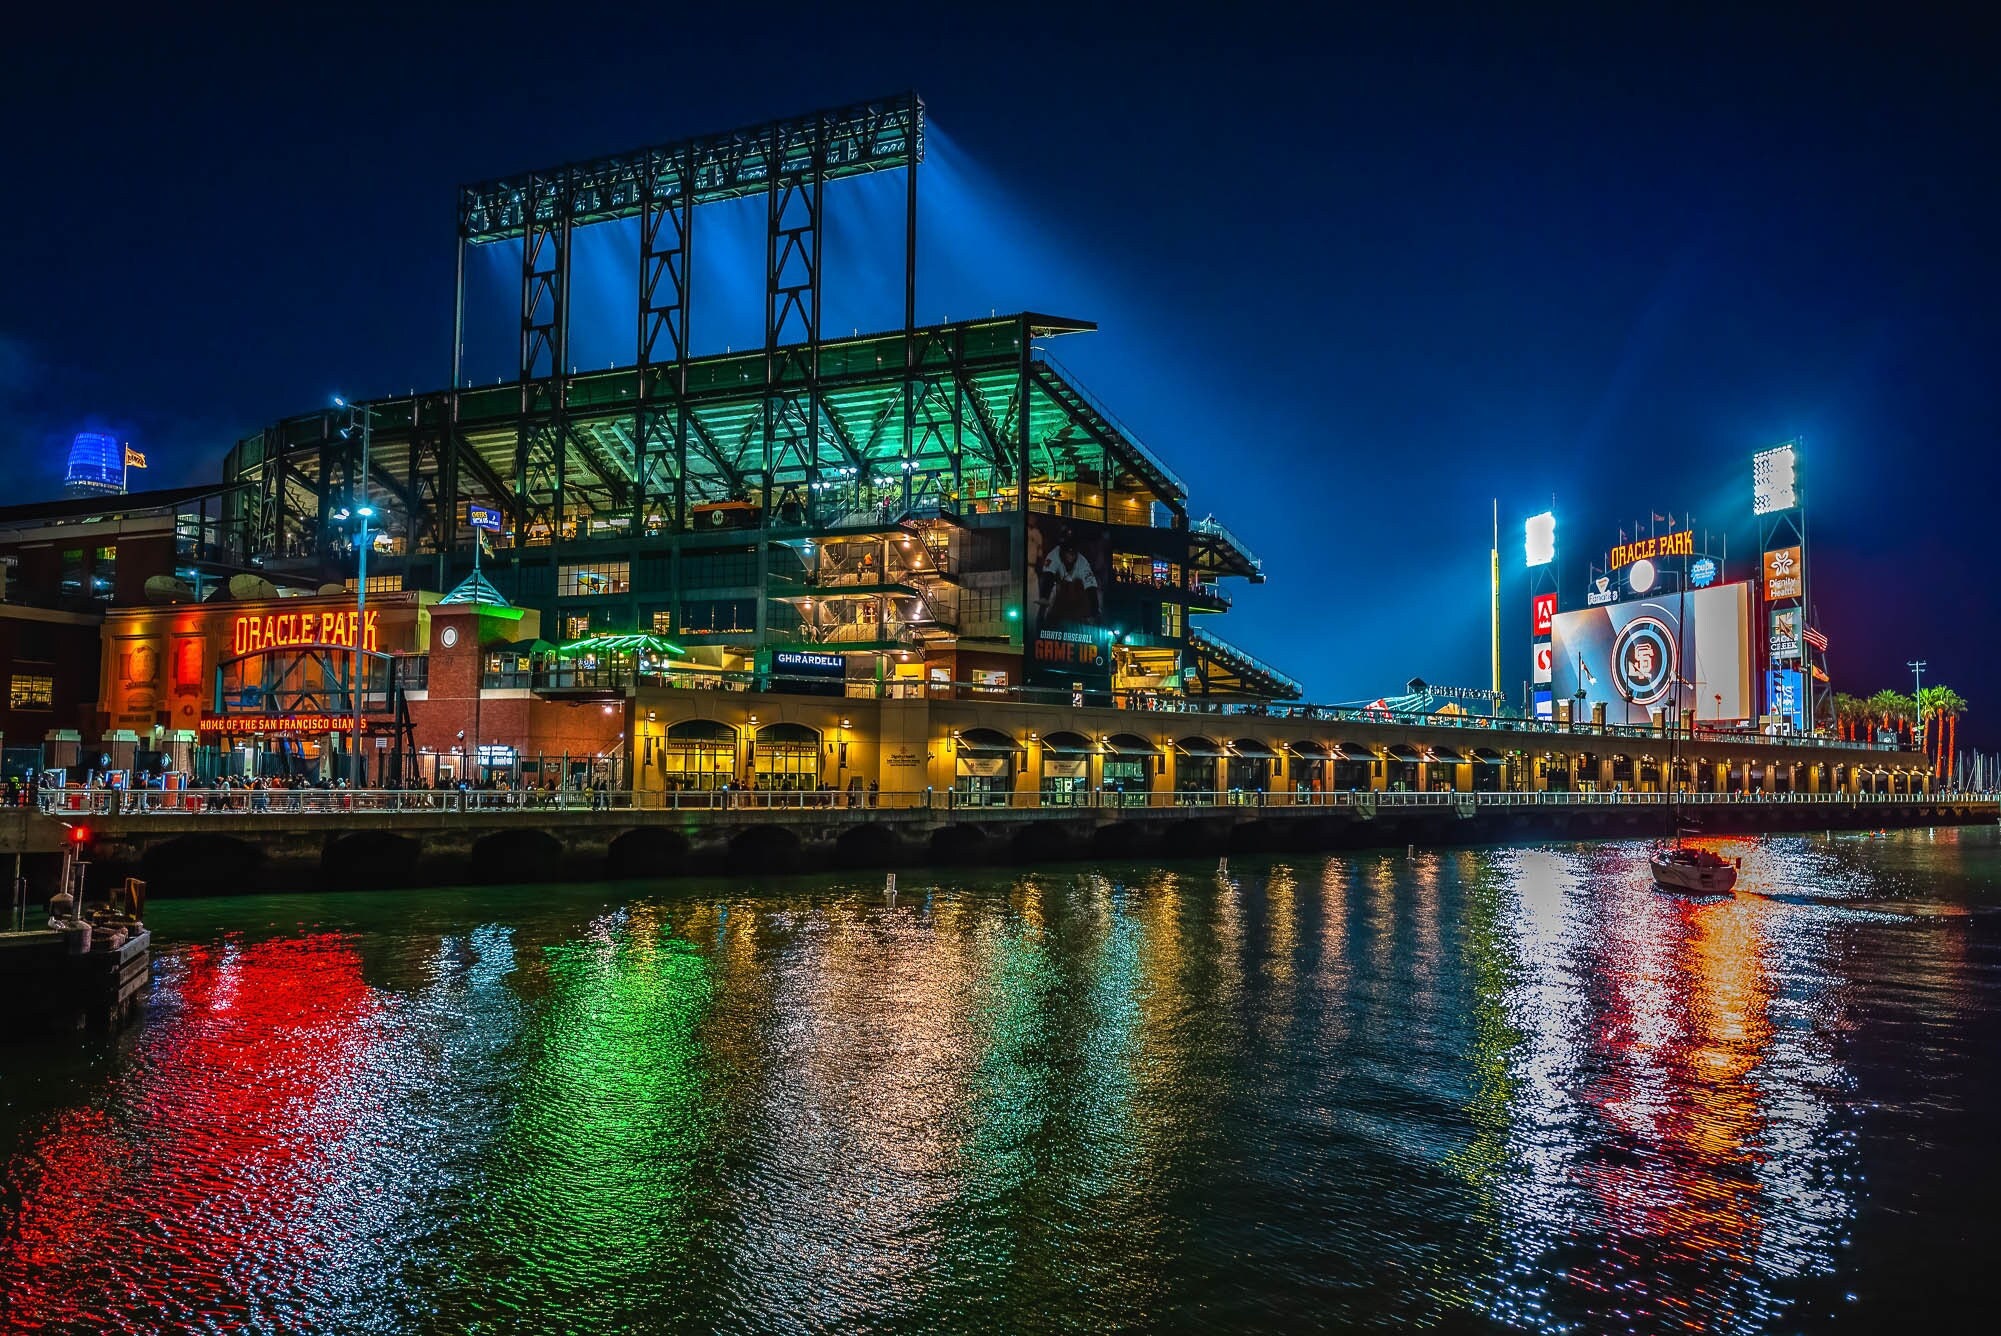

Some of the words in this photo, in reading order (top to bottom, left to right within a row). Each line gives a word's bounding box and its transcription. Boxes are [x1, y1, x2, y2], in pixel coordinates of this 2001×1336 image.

[1611, 539, 1656, 570] ORACLE
[1659, 530, 1693, 555] PARK
[1770, 577, 1796, 589] Dignity
[1588, 590, 1618, 605] Fanatis
[1771, 588, 1795, 597] Health
[235, 614, 314, 655] ORACLE
[1040, 630, 1062, 640] GIANTS
[1063, 632, 1093, 643] BASEBALL
[1034, 639, 1075, 662] GAME
[1078, 642, 1098, 664] UP
[778, 653, 842, 667] GHIRARDELLI
[200, 718, 225, 731] HOME
[226, 718, 238, 730] OF
[239, 718, 257, 730] THE
[259, 718, 277, 730] SAN
[279, 718, 329, 730] FRANCISCO
[331, 717, 368, 730] GIANS
